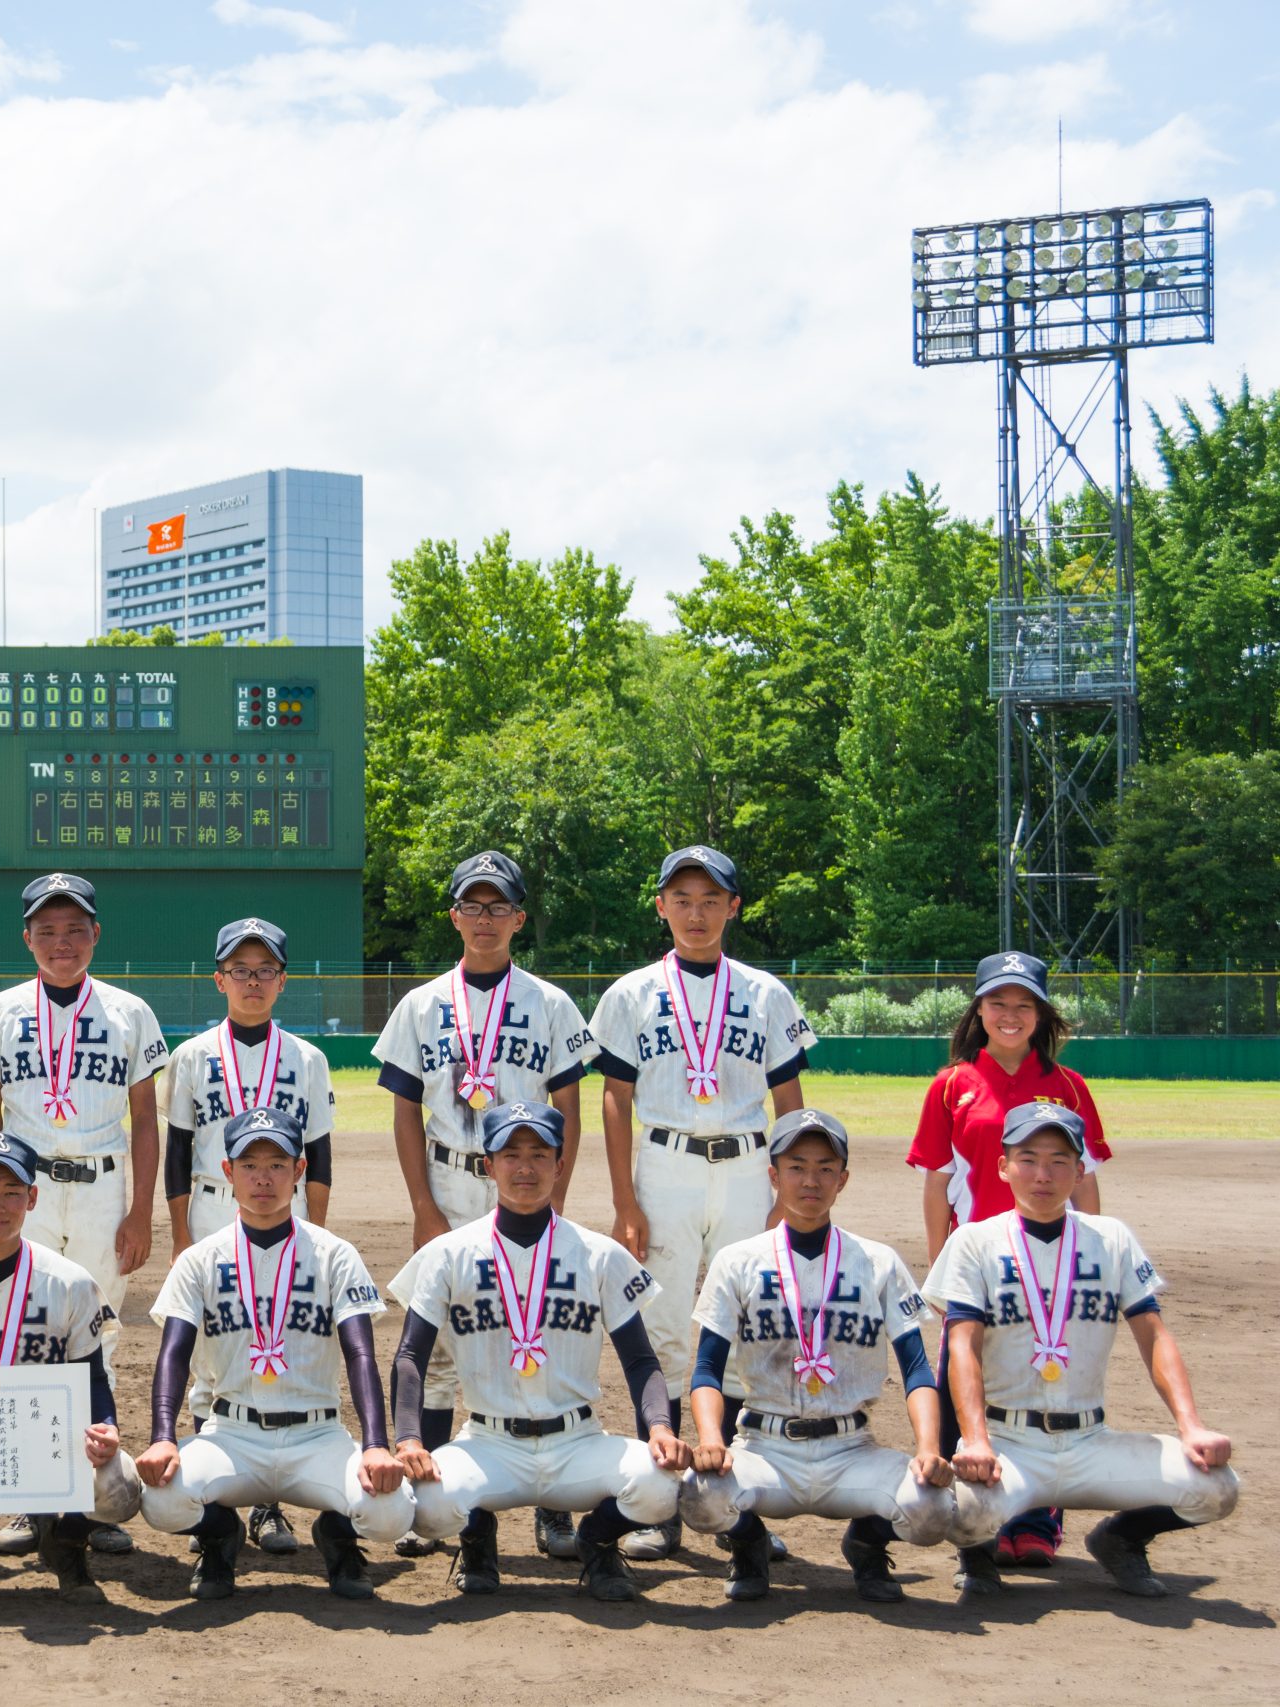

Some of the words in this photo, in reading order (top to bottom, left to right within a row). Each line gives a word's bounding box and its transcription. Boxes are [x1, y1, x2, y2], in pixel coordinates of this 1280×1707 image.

[136, 673, 177, 684] TOTAL
[23, 687, 35, 704] 0
[46, 687, 59, 704] 0
[70, 687, 82, 704] 0
[94, 687, 106, 704] 0
[157, 687, 169, 704] 0
[238, 687, 248, 698] H
[267, 687, 276, 698] B
[239, 701, 248, 712] E
[267, 701, 276, 713] S
[23, 711, 35, 727] 0
[49, 711, 57, 727] 1
[70, 711, 82, 727] 0
[266, 715, 277, 727] O
[30, 763, 55, 777] TN
[64, 770, 74, 783] 5
[91, 770, 101, 783] 8
[120, 770, 130, 783] 2
[148, 770, 157, 783] 3
[174, 770, 184, 783] 7
[204, 770, 210, 783] 1
[230, 770, 239, 783] 9
[257, 770, 266, 783] 6
[286, 770, 295, 783] 4
[252, 808, 270, 826] 森
